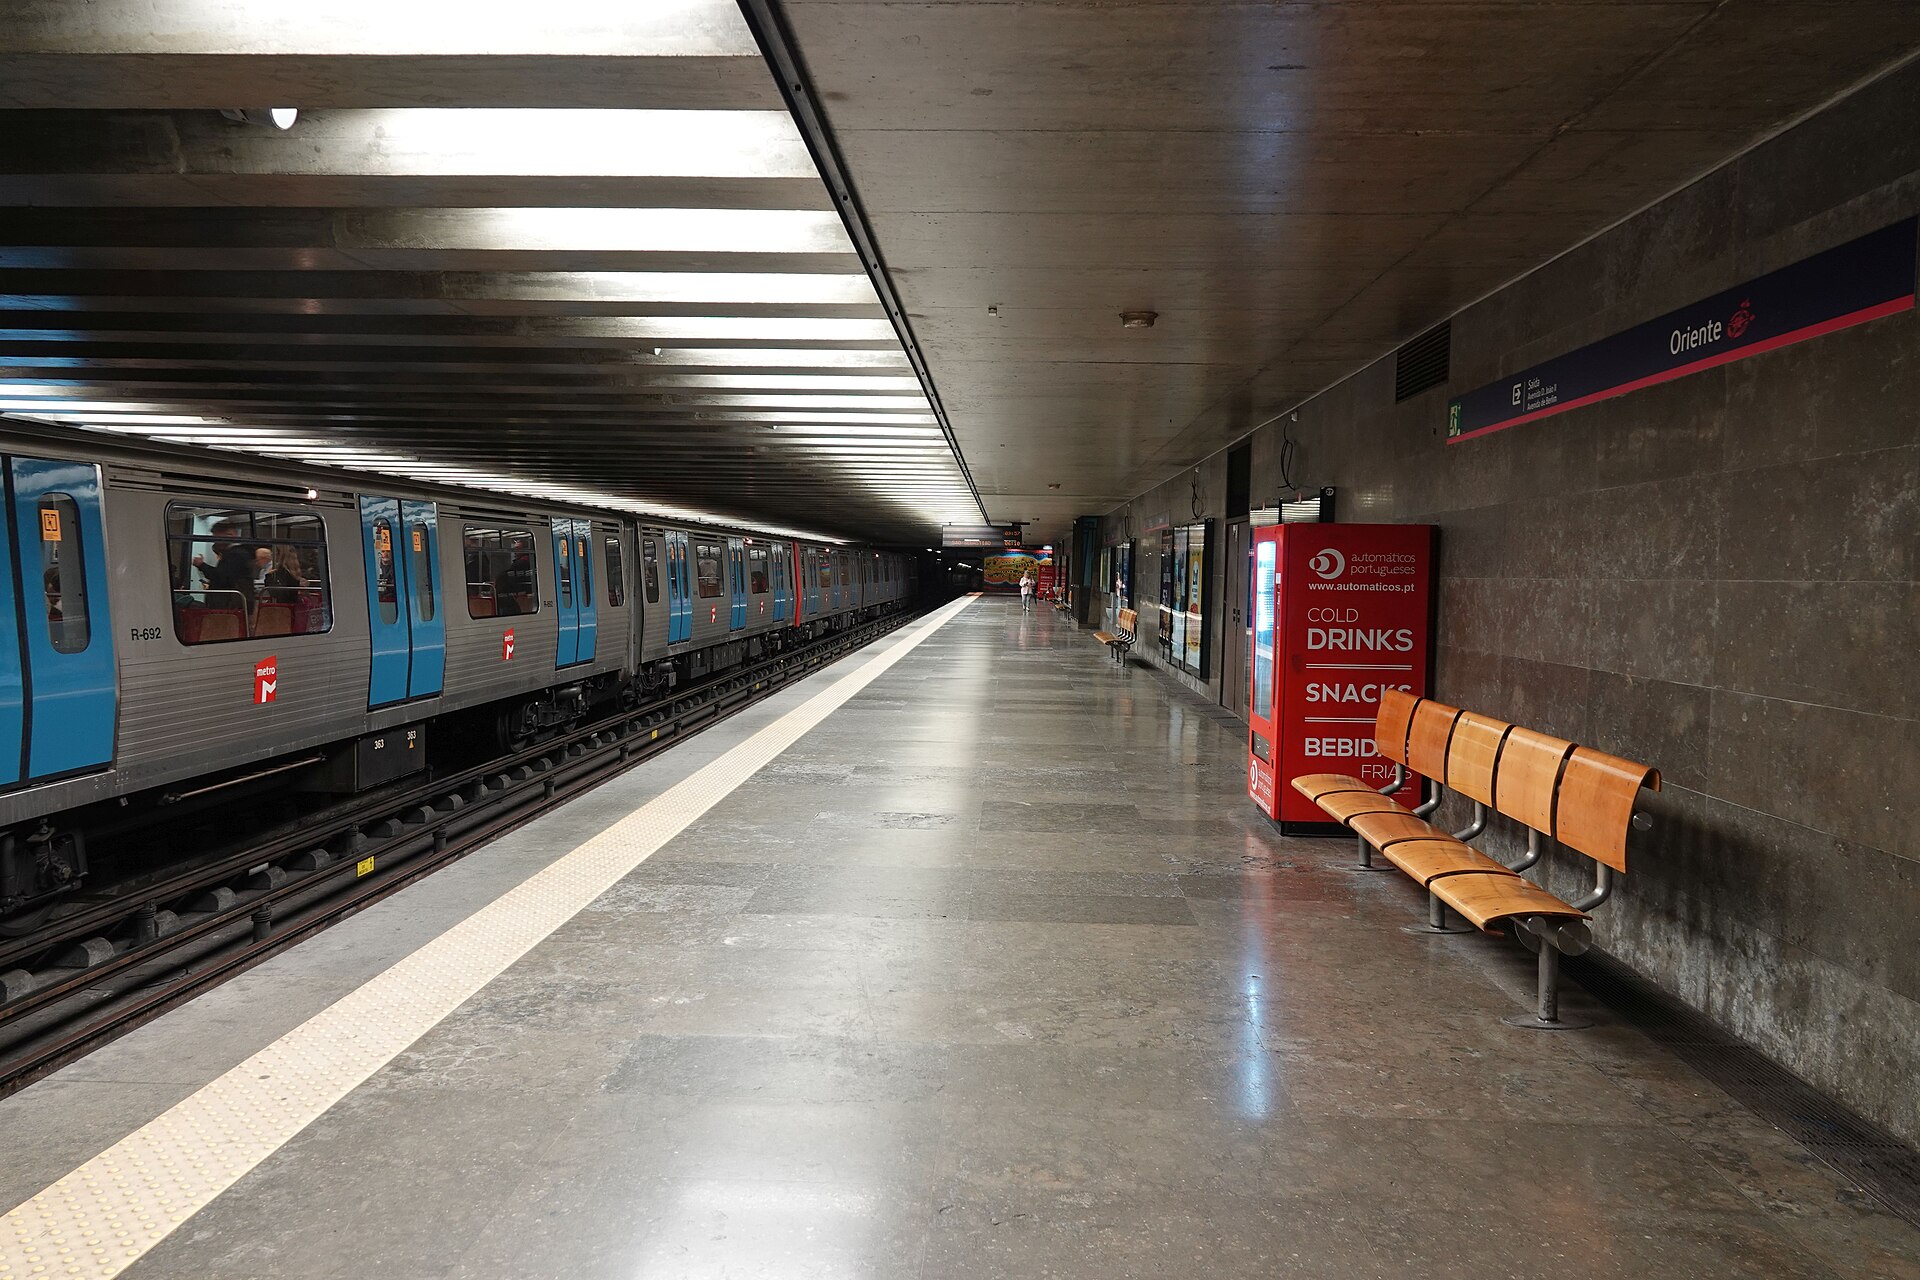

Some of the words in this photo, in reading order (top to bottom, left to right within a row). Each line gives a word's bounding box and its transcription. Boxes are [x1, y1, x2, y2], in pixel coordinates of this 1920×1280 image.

[1670, 319, 1722, 355] Oriente
[1351, 552, 1416, 563] automáticos
[1350, 565, 1416, 577] portugueses
[1308, 582, 1415, 593] www.automaticos.pt
[1307, 607, 1359, 623] COLD
[130, 627, 162, 641] R-692
[1307, 628, 1414, 652] DRINKS
[256, 666, 276, 677] metro
[1305, 683, 1412, 703] SNAC
[407, 730, 417, 740] 363
[374, 738, 385, 750] 363
[1305, 737, 1410, 758] BEBID
